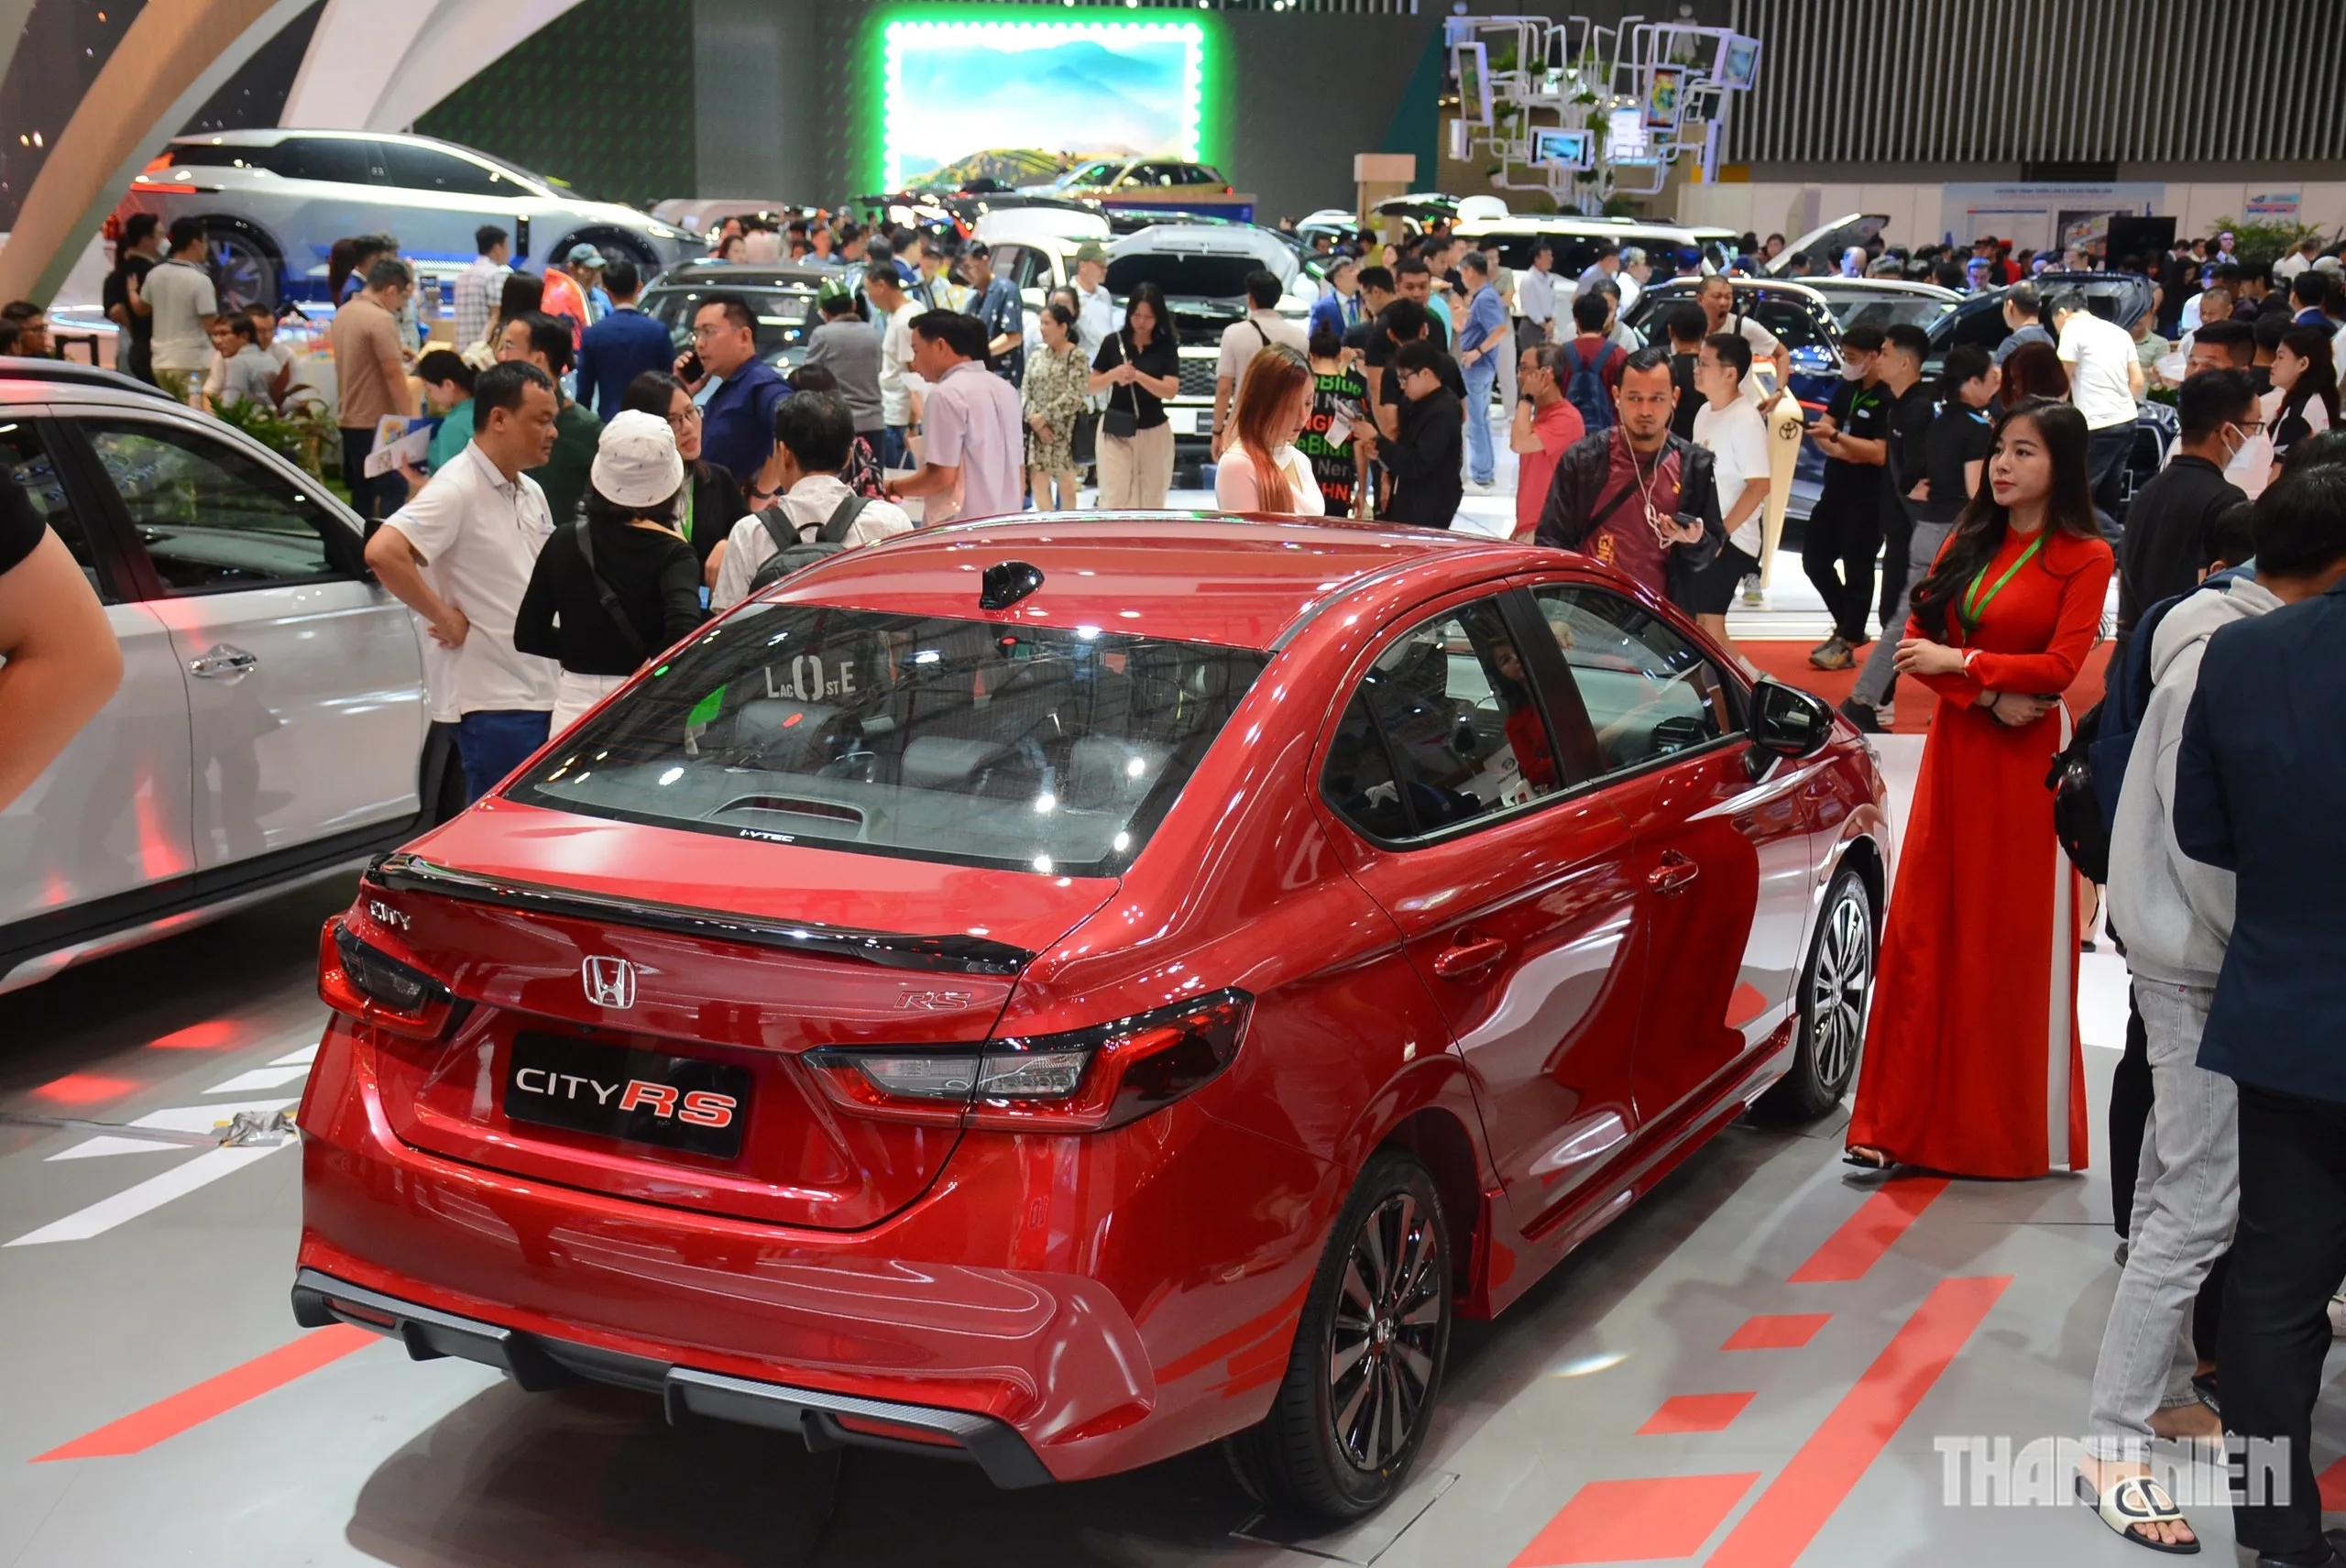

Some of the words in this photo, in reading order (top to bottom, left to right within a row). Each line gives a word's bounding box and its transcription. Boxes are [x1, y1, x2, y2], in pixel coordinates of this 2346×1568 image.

[765, 654, 856, 701] LACOSTE
[370, 900, 411, 931] CITY
[893, 991, 971, 1010] RS
